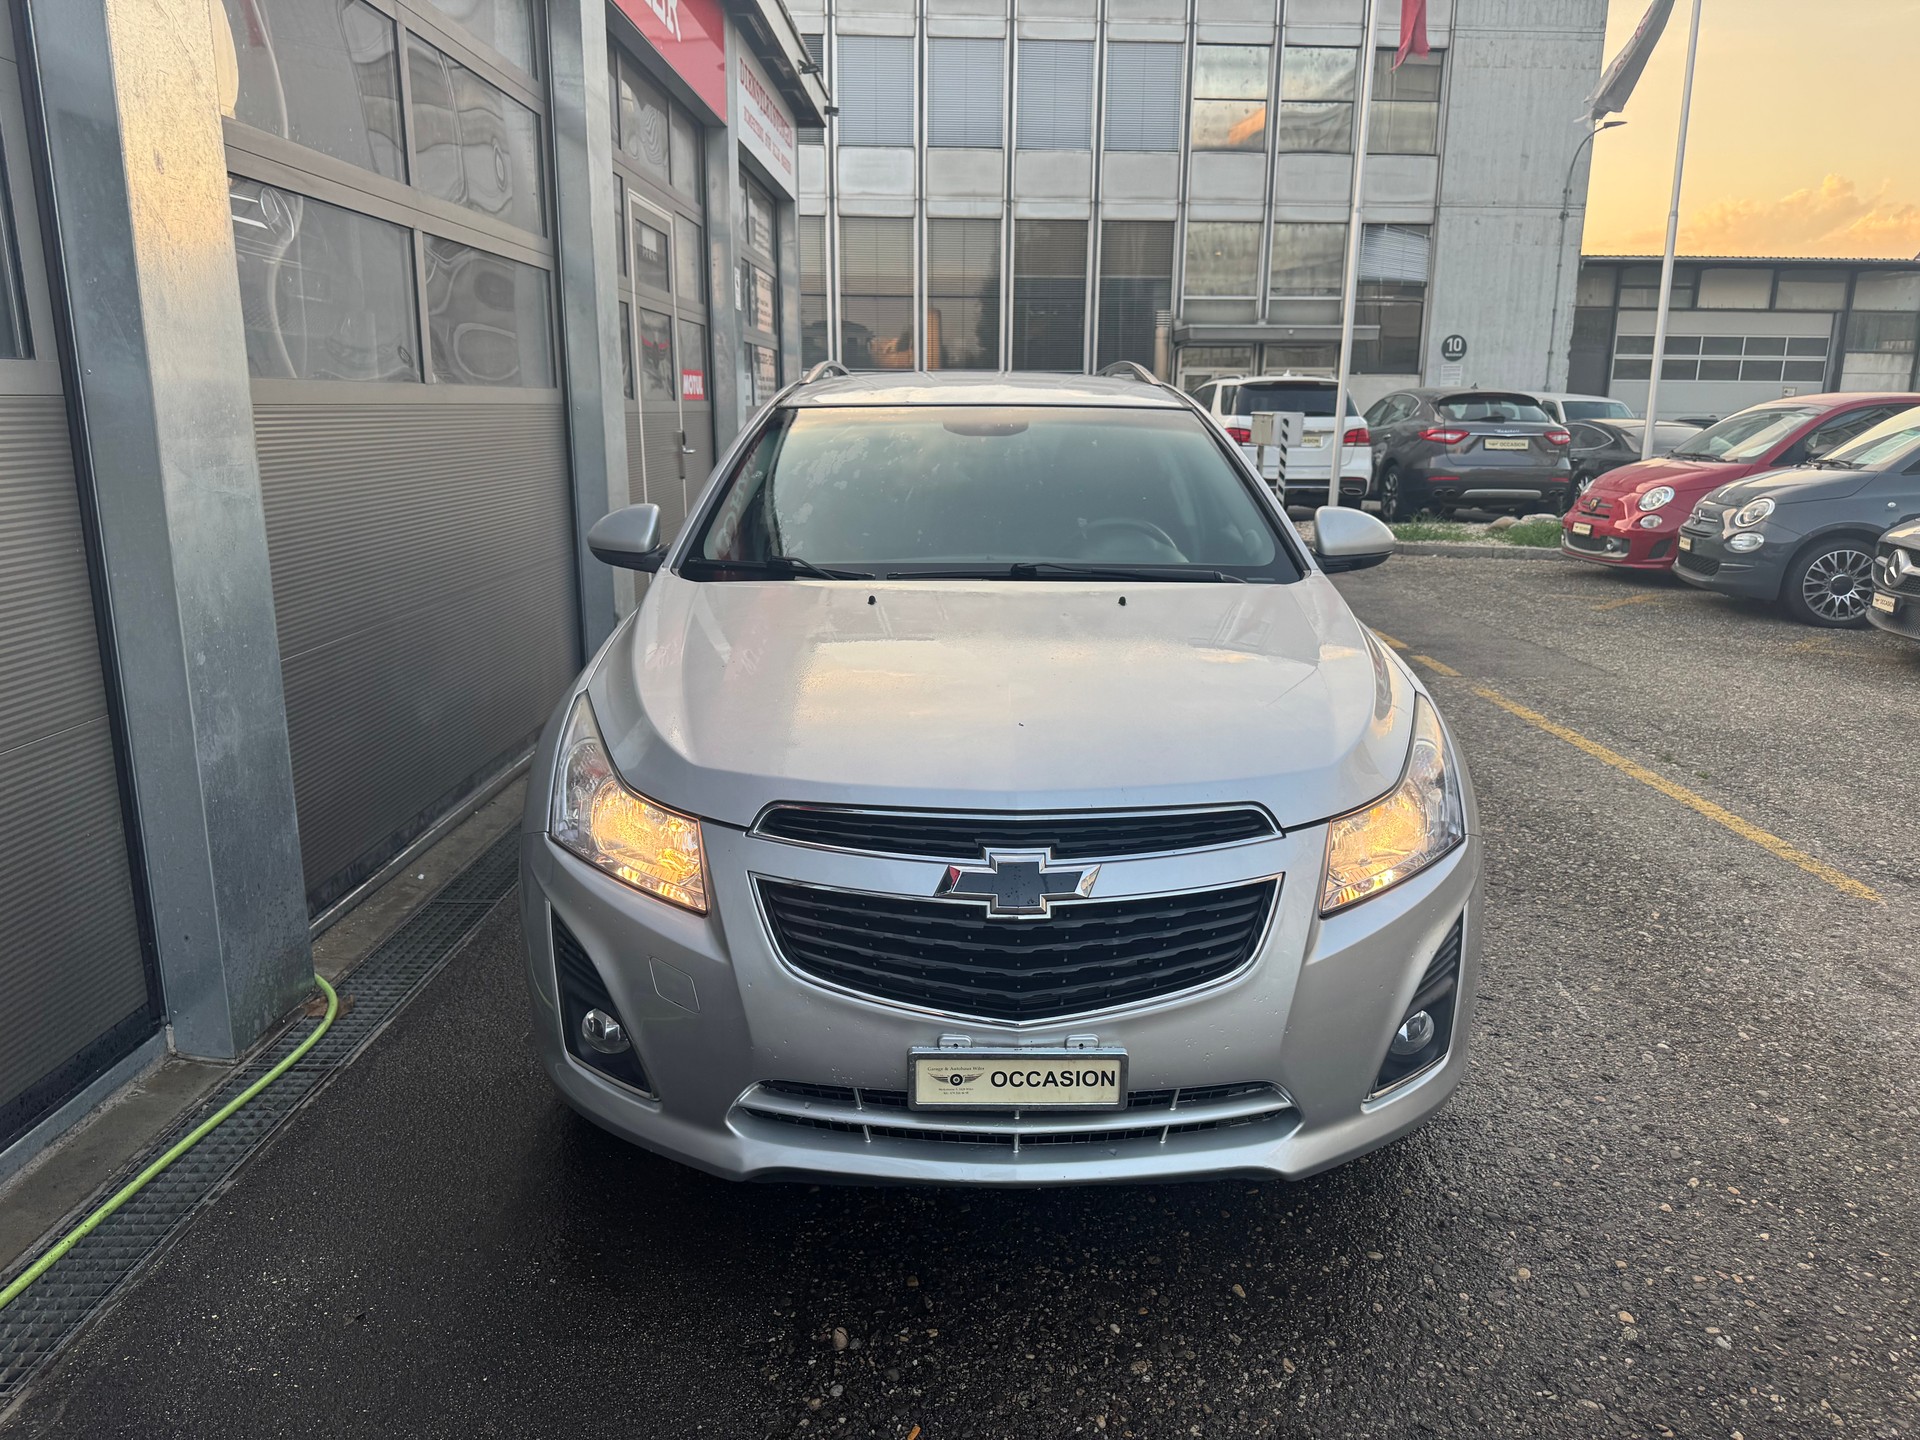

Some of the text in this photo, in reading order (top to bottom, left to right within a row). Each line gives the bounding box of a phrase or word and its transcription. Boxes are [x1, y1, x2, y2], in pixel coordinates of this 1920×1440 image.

[1446, 338, 1462, 351] 10
[682, 374, 703, 395] MOTUL
[990, 1070, 1116, 1088] OCCASION
